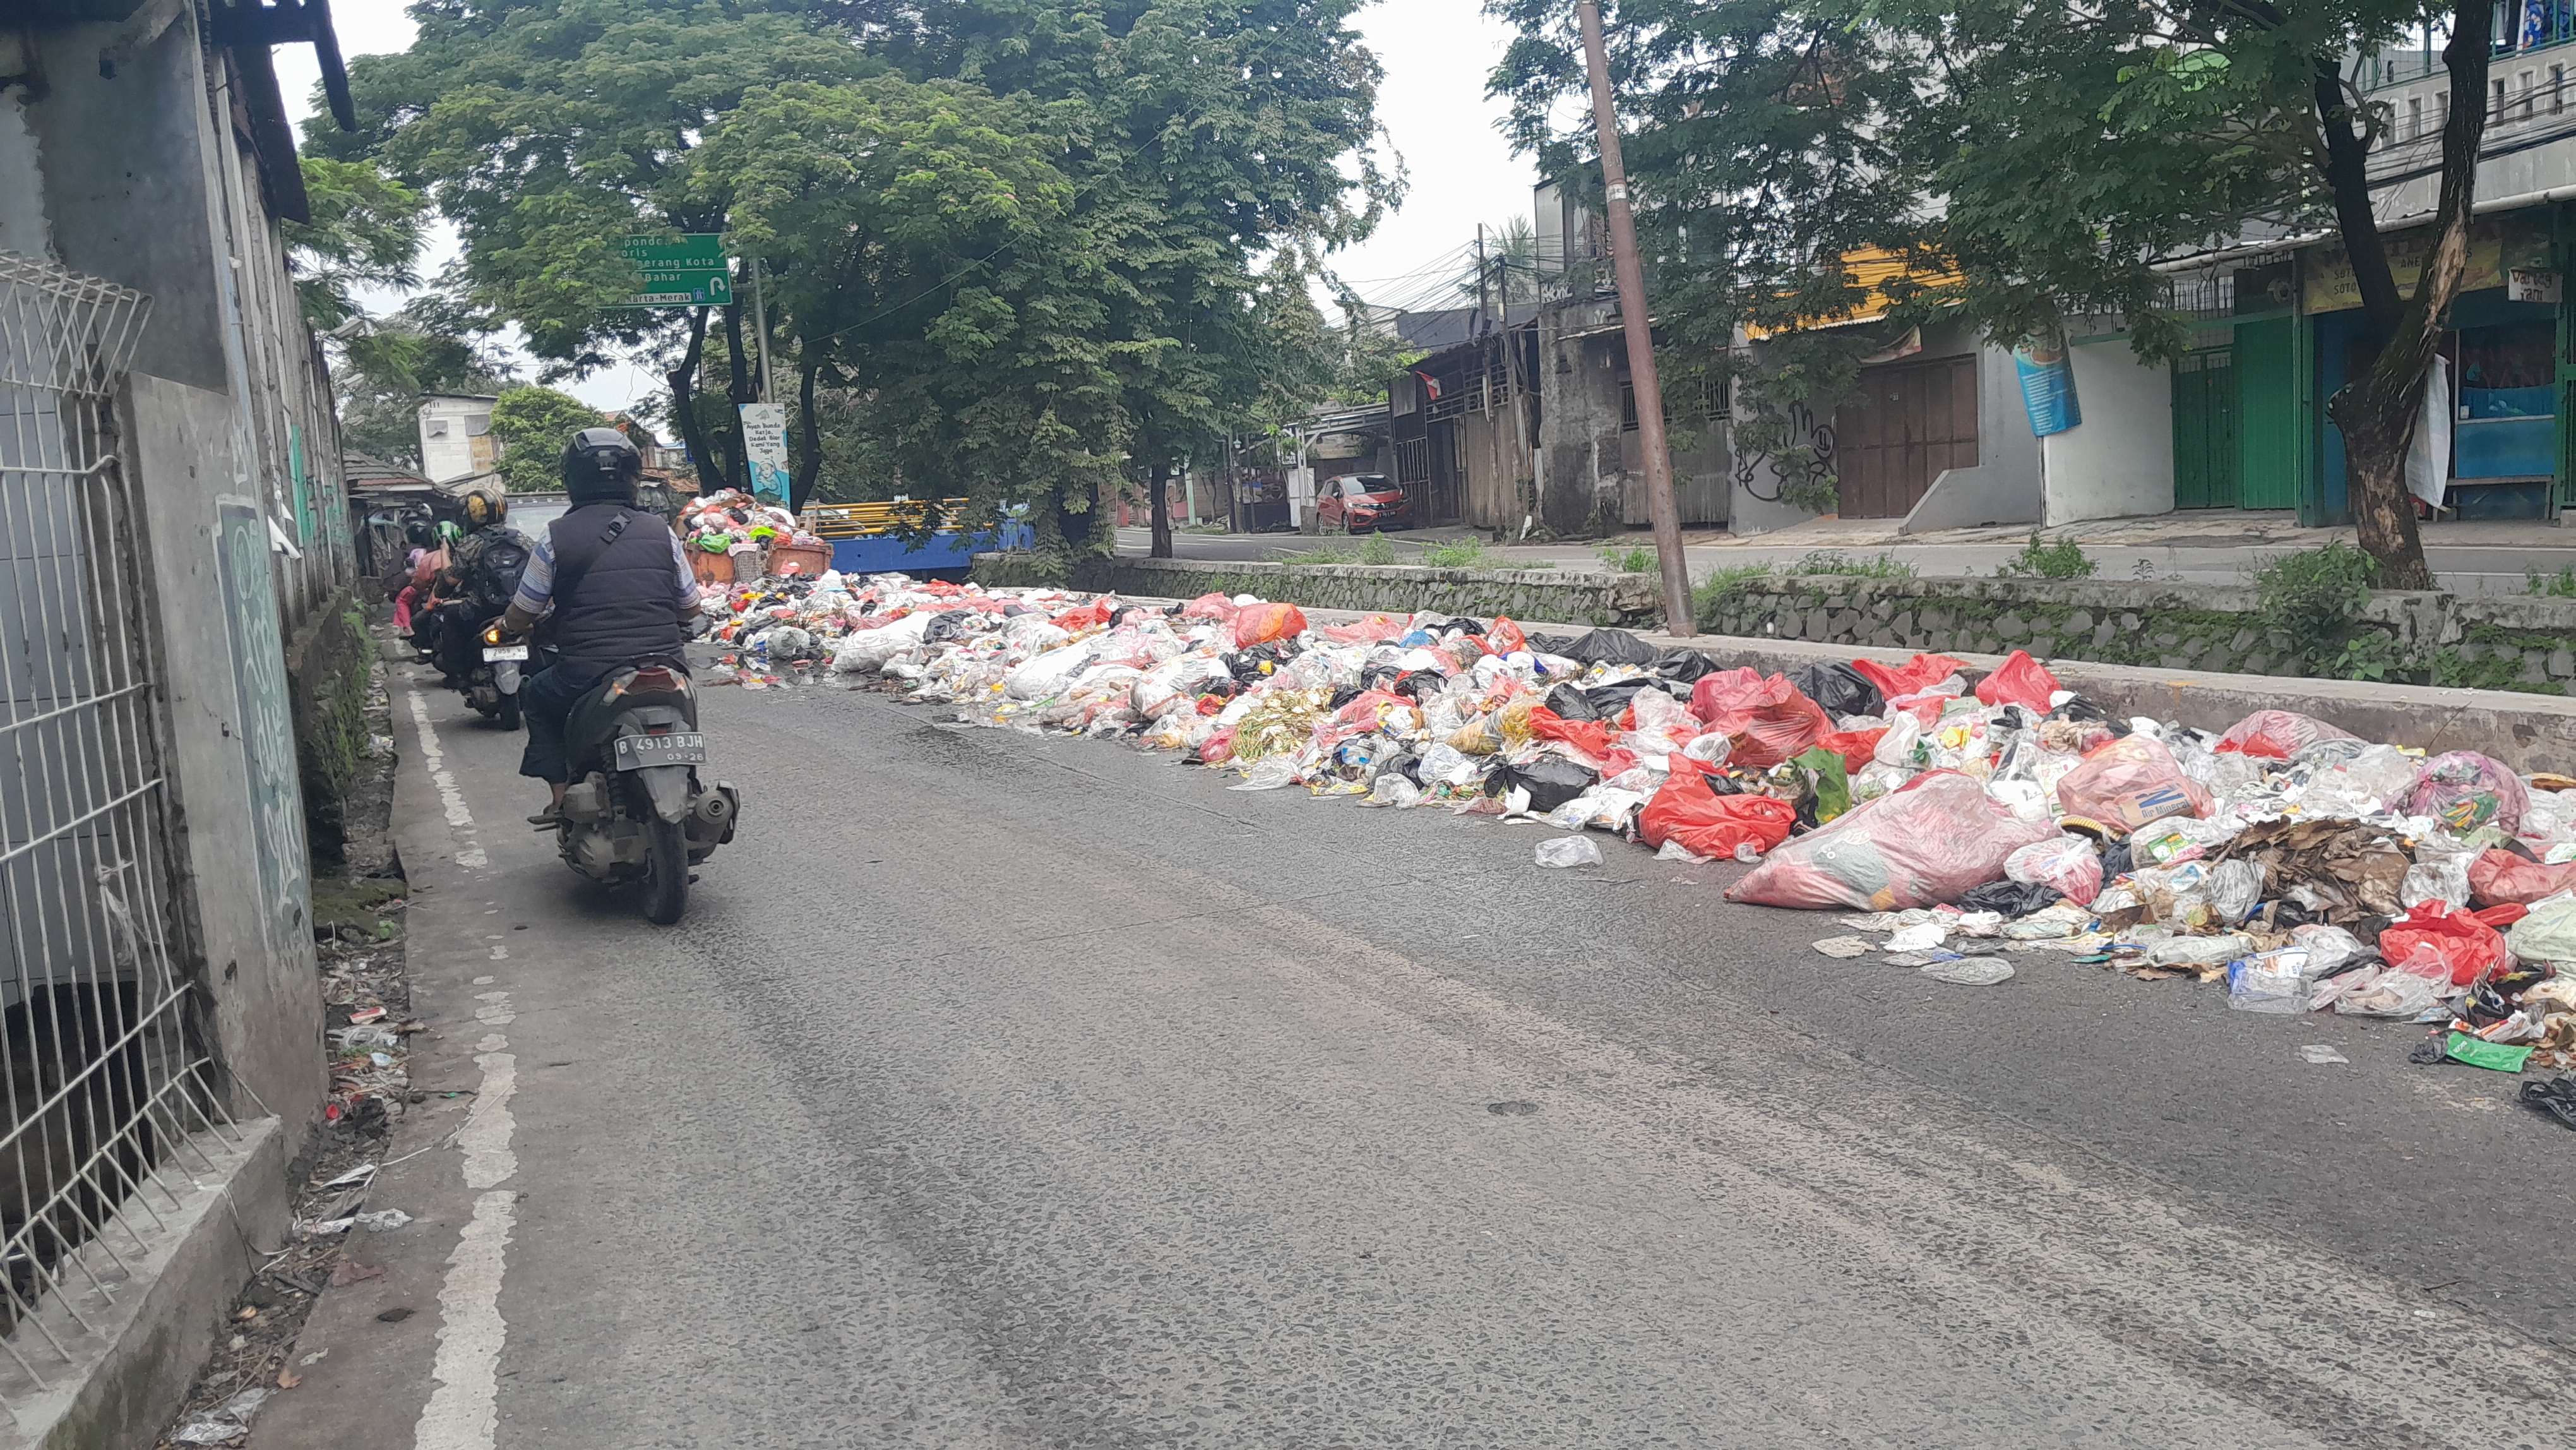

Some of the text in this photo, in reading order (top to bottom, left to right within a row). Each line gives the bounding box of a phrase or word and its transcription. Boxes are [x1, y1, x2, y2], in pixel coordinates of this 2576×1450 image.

[686, 257, 715, 266] Kota
[645, 273, 681, 282] Bahar
[619, 735, 703, 754] B 4913 BJH
[2155, 799, 2191, 815] Mineral
